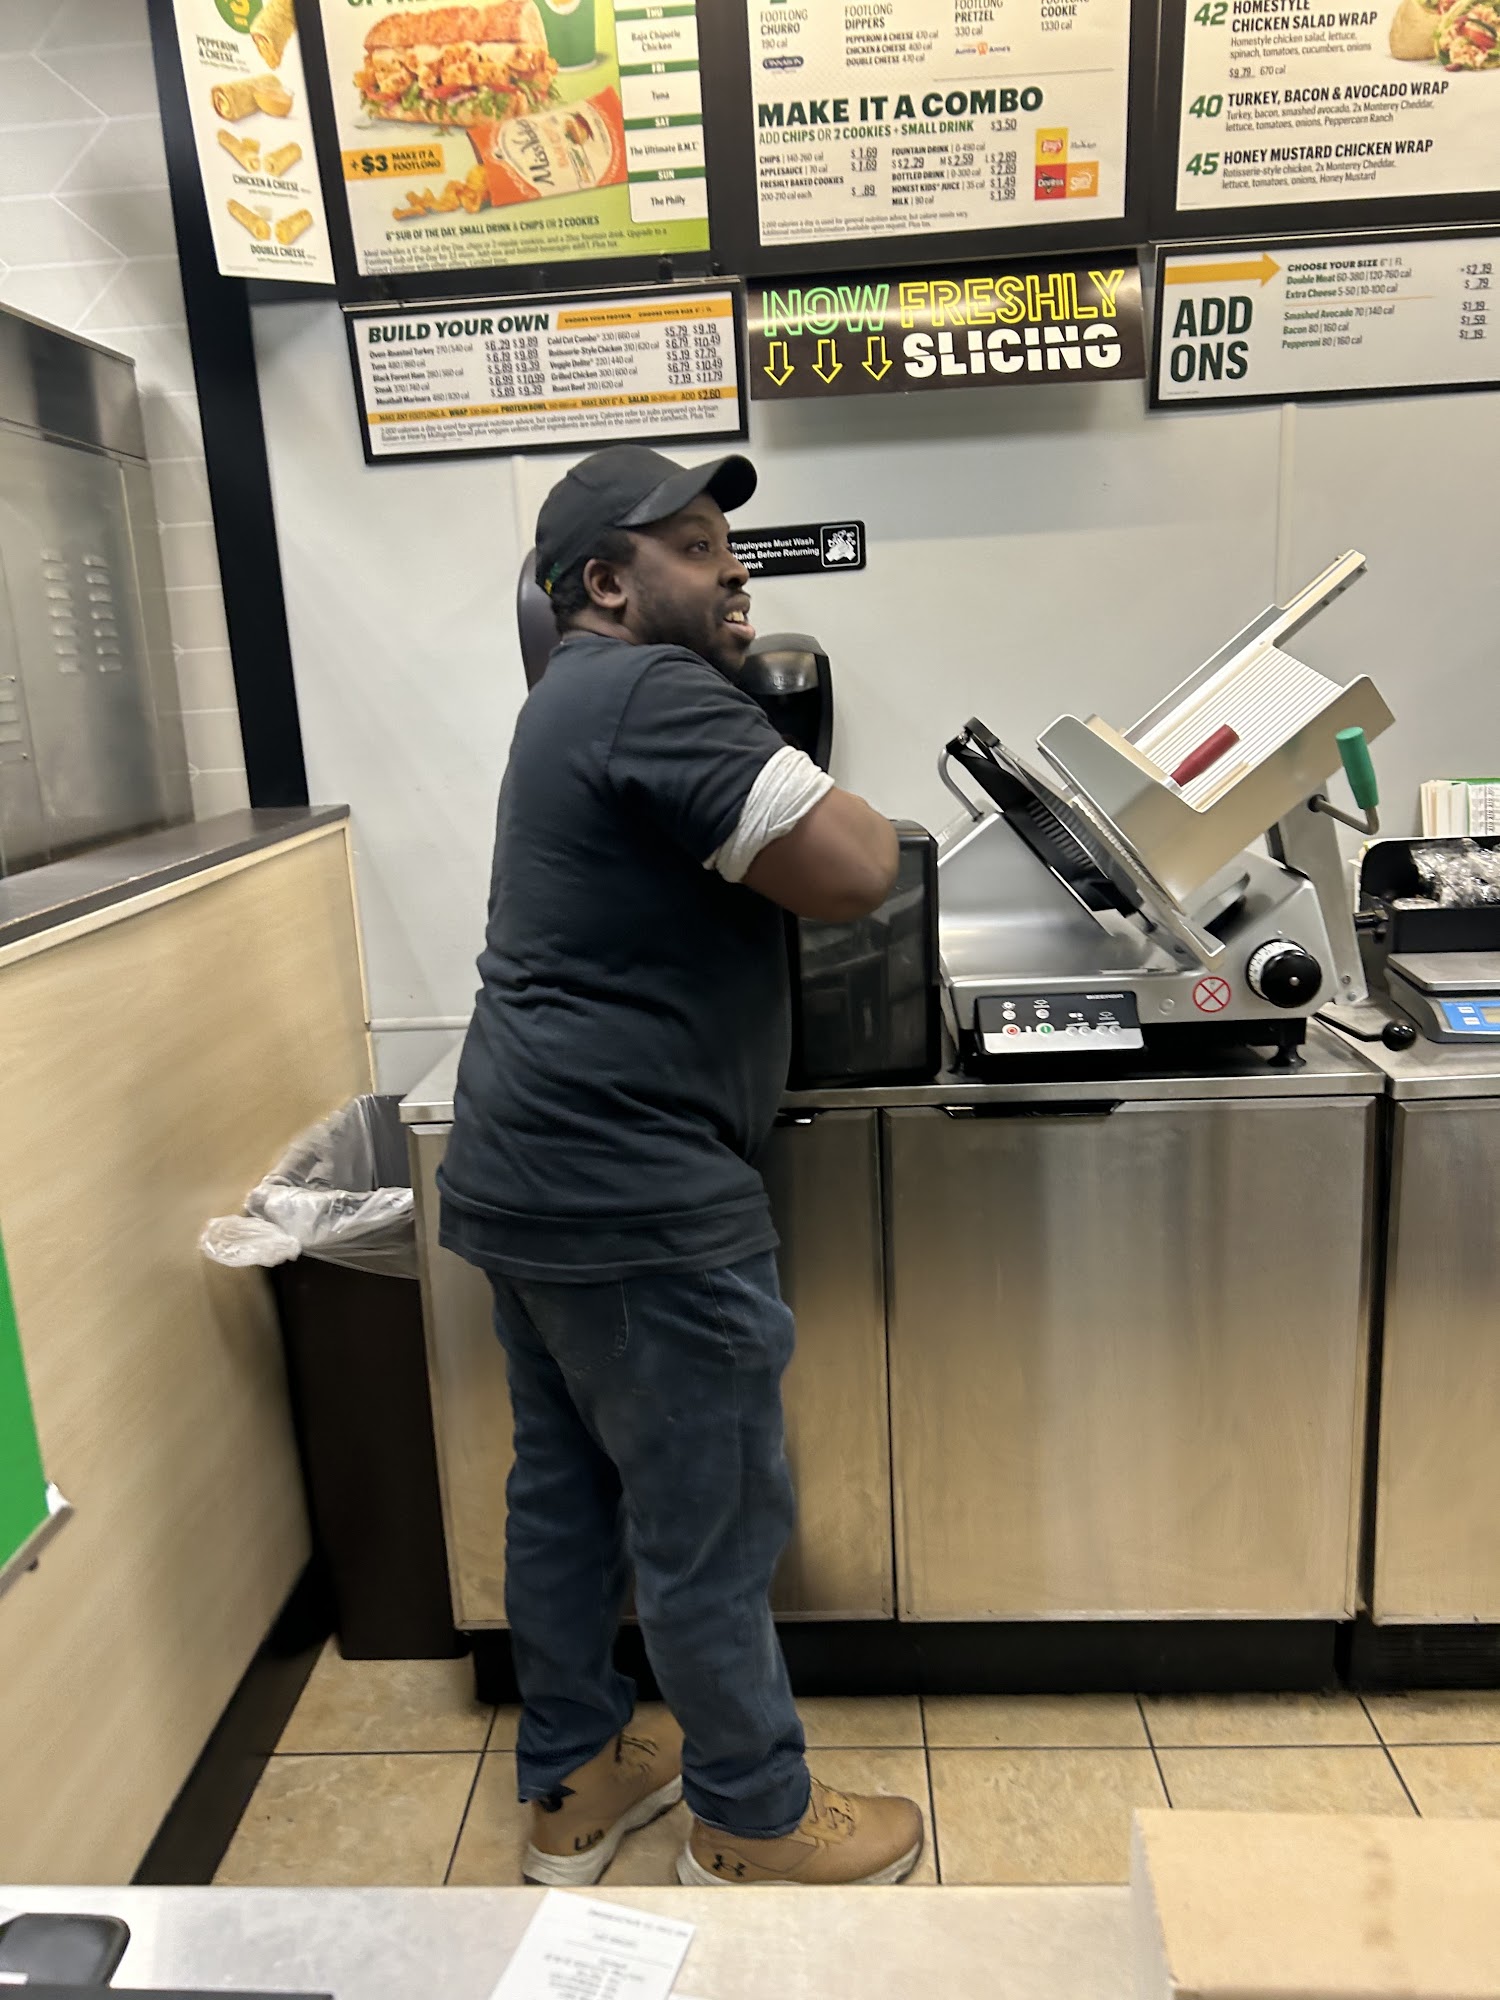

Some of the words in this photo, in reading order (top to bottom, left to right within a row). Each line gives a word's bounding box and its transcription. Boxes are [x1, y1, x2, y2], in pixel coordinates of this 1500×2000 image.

[845, 4, 893, 16] FOOTLONG
[955, 0, 1003, 9] FOOTLONG
[1234, 0, 1310, 14] HOMESTYLE
[646, 8, 663, 19] THU
[760, 10, 808, 22] FOOTLONG
[1041, 5, 1077, 18] COOKIE
[1194, 2, 1228, 26] 42
[955, 12, 994, 23] PRETZEL
[1232, 16, 1289, 33] CHICKEN
[1293, 14, 1335, 29] SALAD
[1339, 11, 1377, 26] WRAP
[761, 23, 800, 35] CHURRO
[845, 17, 885, 30] DIPPERS
[1041, 20, 1059, 32] 1330
[1061, 20, 1072, 30] cal
[955, 27, 970, 36] 330
[972, 25, 983, 36] cal
[632, 32, 648, 42] Baja
[650, 31, 680, 40] Chipotle
[846, 34, 882, 43] PEPPERONI
[889, 32, 913, 41] CHEESE
[1231, 38, 1272, 47] Homestyle
[1274, 35, 1303, 44] chicken
[641, 43, 672, 52] Chicken
[846, 46, 875, 55] CHICKEN
[882, 44, 906, 53] CHEESE
[1347, 43, 1371, 52] onions
[206, 50, 234, 63] CHEESE
[846, 58, 872, 66] DOUBLE
[652, 63, 665, 73] FRI
[1260, 67, 1274, 75] 670
[1275, 66, 1286, 74] cal
[652, 91, 669, 99] Tuna
[1228, 91, 1281, 107] TURKEY,
[1284, 89, 1329, 103] BACON
[1332, 88, 1341, 100] &
[1344, 84, 1408, 100] AVOCADO
[1411, 81, 1449, 96] WRAP
[758, 98, 849, 128] MAKE
[860, 95, 888, 121] IT
[893, 95, 916, 119] A
[922, 87, 1043, 117] COMBO
[1189, 95, 1223, 118] 40
[1282, 106, 1316, 117] smashed
[1352, 103, 1362, 112] 2x
[1363, 101, 1399, 112] Monterey
[655, 118, 669, 127] SAT
[1324, 114, 1368, 128] Peppercorn
[1370, 113, 1393, 123] Ranch
[759, 132, 780, 145] ADD
[782, 129, 815, 143] CHIPS
[817, 129, 831, 140] OR
[834, 128, 840, 140] 2
[843, 125, 891, 139] COOKIES
[901, 122, 937, 136] SMALL
[939, 120, 974, 133] DRINK
[991, 119, 1017, 132] $3.50
[630, 146, 643, 156] The
[645, 143, 676, 154] Ultimate
[892, 146, 926, 156] FOUNTAIN
[927, 145, 948, 153] DRINK
[1224, 149, 1268, 164] HONEY
[1270, 145, 1331, 161] MUSTARD
[1335, 142, 1392, 157] CHICKEN
[1395, 140, 1433, 154] WRAP
[392, 152, 417, 160] MAKE
[419, 151, 426, 159] IT
[760, 155, 780, 164] CHIPS
[393, 160, 441, 171] FOOTLONG
[1186, 153, 1220, 176] 45
[1223, 166, 1281, 179] Rotisserie-style
[1315, 163, 1324, 172] 2x
[1326, 161, 1360, 172] Monterey
[658, 170, 674, 180] SUN
[760, 167, 802, 176] APPLESAUCE
[232, 175, 265, 187] CHICKEN
[273, 180, 299, 191] CHEESE
[814, 176, 844, 185] COOKIES
[1319, 173, 1343, 184] Honey
[1345, 171, 1375, 181] Mustard
[892, 184, 918, 193] HONEST
[941, 182, 959, 191] JUICE
[651, 197, 664, 206] The
[666, 195, 685, 205] Philly
[892, 197, 908, 206] MILK
[396, 230, 412, 240] SUB
[414, 230, 423, 239] OF
[425, 229, 438, 239] THE
[460, 224, 484, 235] SMALL
[487, 223, 511, 233] DRINK
[520, 219, 544, 231] CHIPS
[558, 217, 563, 228] 2
[565, 216, 599, 227] COOKIES
[250, 244, 278, 256] DOUBLE
[280, 248, 305, 258] CHEESE
[1288, 263, 1327, 272] CHOOSE
[1330, 261, 1355, 270] YOUR
[1357, 259, 1378, 268] SIZE
[1286, 274, 1315, 285] Double
[1316, 273, 1335, 283] Meat
[1286, 289, 1306, 299] Extra
[1308, 288, 1337, 297] Cheese
[762, 284, 891, 337] NOW
[900, 270, 1124, 328] FRESHLY
[1173, 296, 1253, 338] ADD
[1284, 310, 1319, 320] Smashed
[1320, 309, 1353, 318] Avocado
[369, 323, 430, 343] BUILD
[435, 318, 493, 338] YOUR
[498, 314, 549, 333] OWN
[1283, 325, 1307, 335] Bacon
[598, 345, 622, 353] Chicken
[1281, 339, 1320, 350] Pepperoni
[370, 350, 386, 359] Oven
[414, 347, 434, 356] Turkey
[903, 323, 1122, 379] SLICING
[550, 361, 570, 369] Veggie
[1170, 340, 1249, 382] ONS
[373, 373, 389, 382] Black
[551, 372, 572, 381] Grilled
[573, 371, 597, 379] Chicken
[375, 385, 392, 394] Steak
[552, 383, 570, 392] Roast
[572, 383, 585, 391] Beef
[404, 394, 431, 402] Marinara
[698, 389, 721, 399] $2.60
[731, 541, 772, 551] Employees
[773, 539, 792, 547] Must
[792, 537, 814, 546] Wash
[757, 551, 781, 559] Before
[783, 548, 819, 557] Returning
[743, 561, 763, 569] Work
